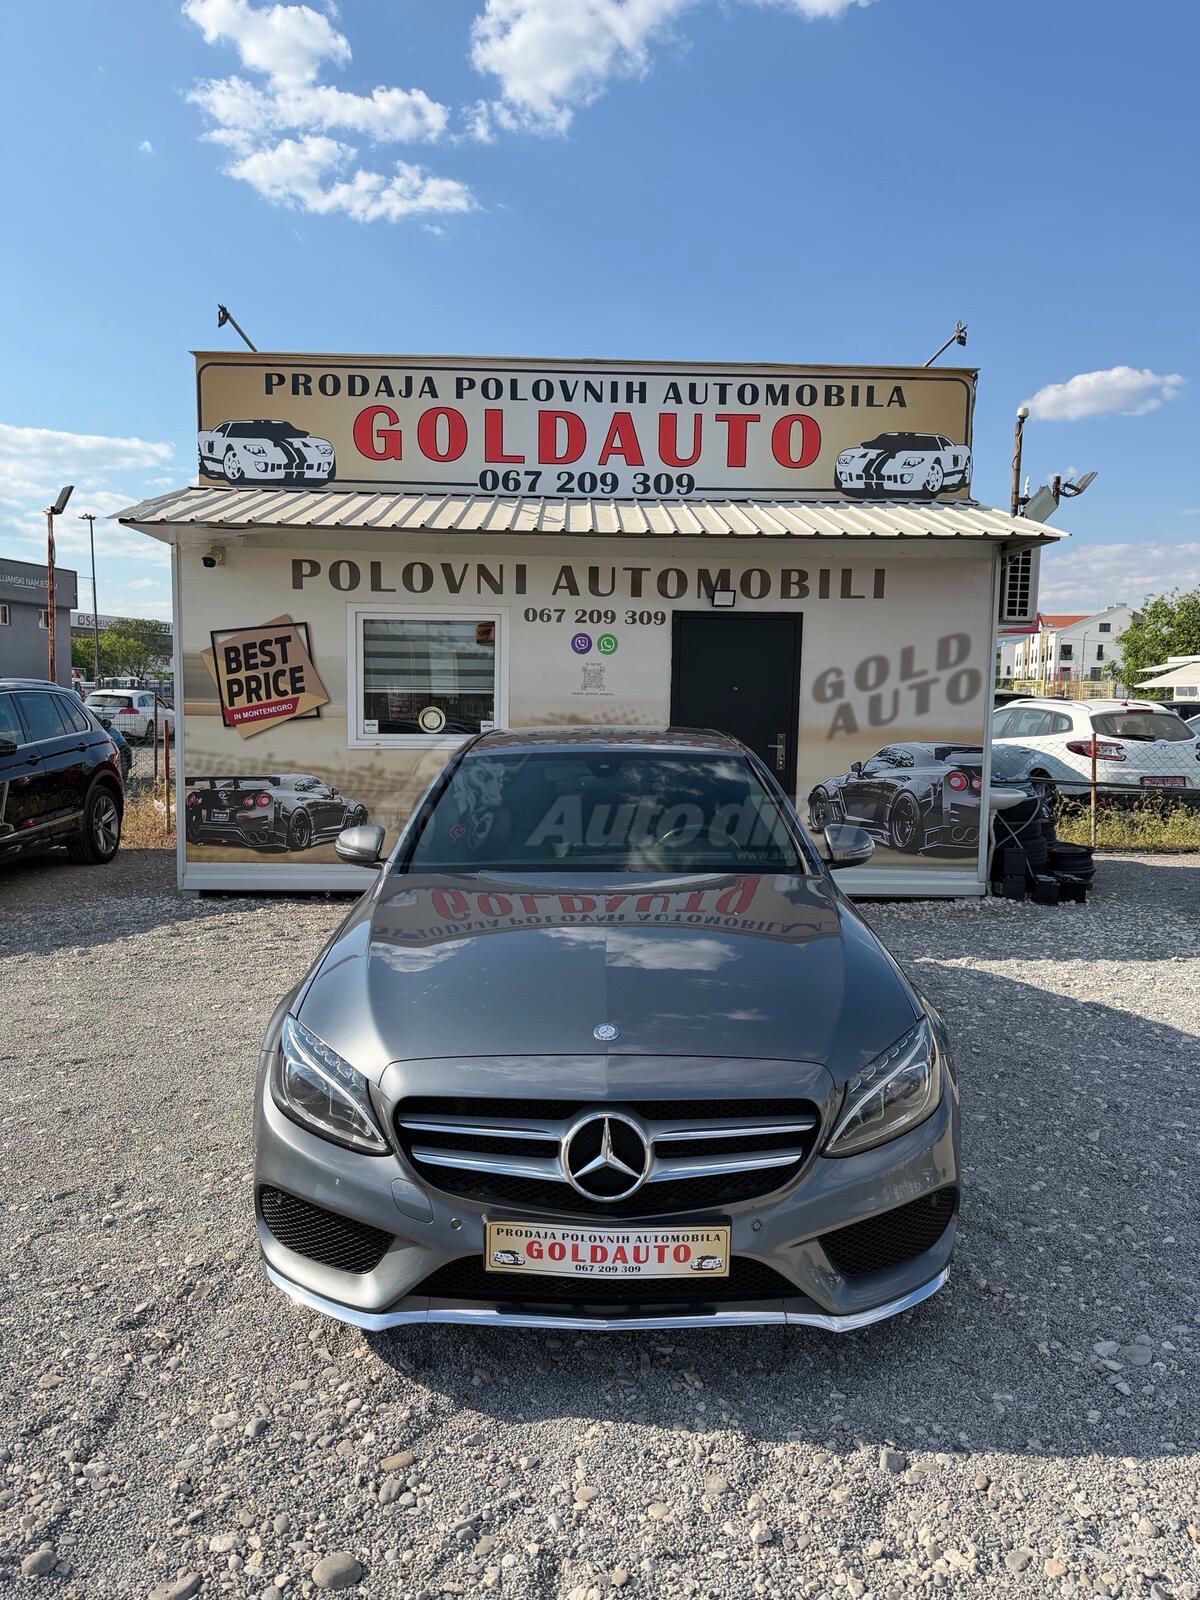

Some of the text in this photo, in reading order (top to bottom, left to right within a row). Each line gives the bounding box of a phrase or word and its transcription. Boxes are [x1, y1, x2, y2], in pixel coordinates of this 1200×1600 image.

[264, 372, 908, 409] PRODAJA POLOVNIH AUTOMOBILA
[352, 404, 822, 469] GOLDAUTO
[478, 469, 696, 496] 067 209 309
[291, 558, 887, 601] POLOVNI AUTOMOBILI
[523, 607, 667, 627] 067 209 309
[223, 634, 292, 675] BEST
[811, 632, 972, 705] GOLD
[226, 665, 306, 708] PRICE
[826, 667, 983, 741] AUTO
[233, 703, 294, 721] IN MONTENEGRO
[496, 1227, 722, 1244] PRODAJA POLOVNIH AUTOMOBILA
[525, 1240, 692, 1265] GOLDAUTO
[575, 1263, 642, 1274] 067 209 309
